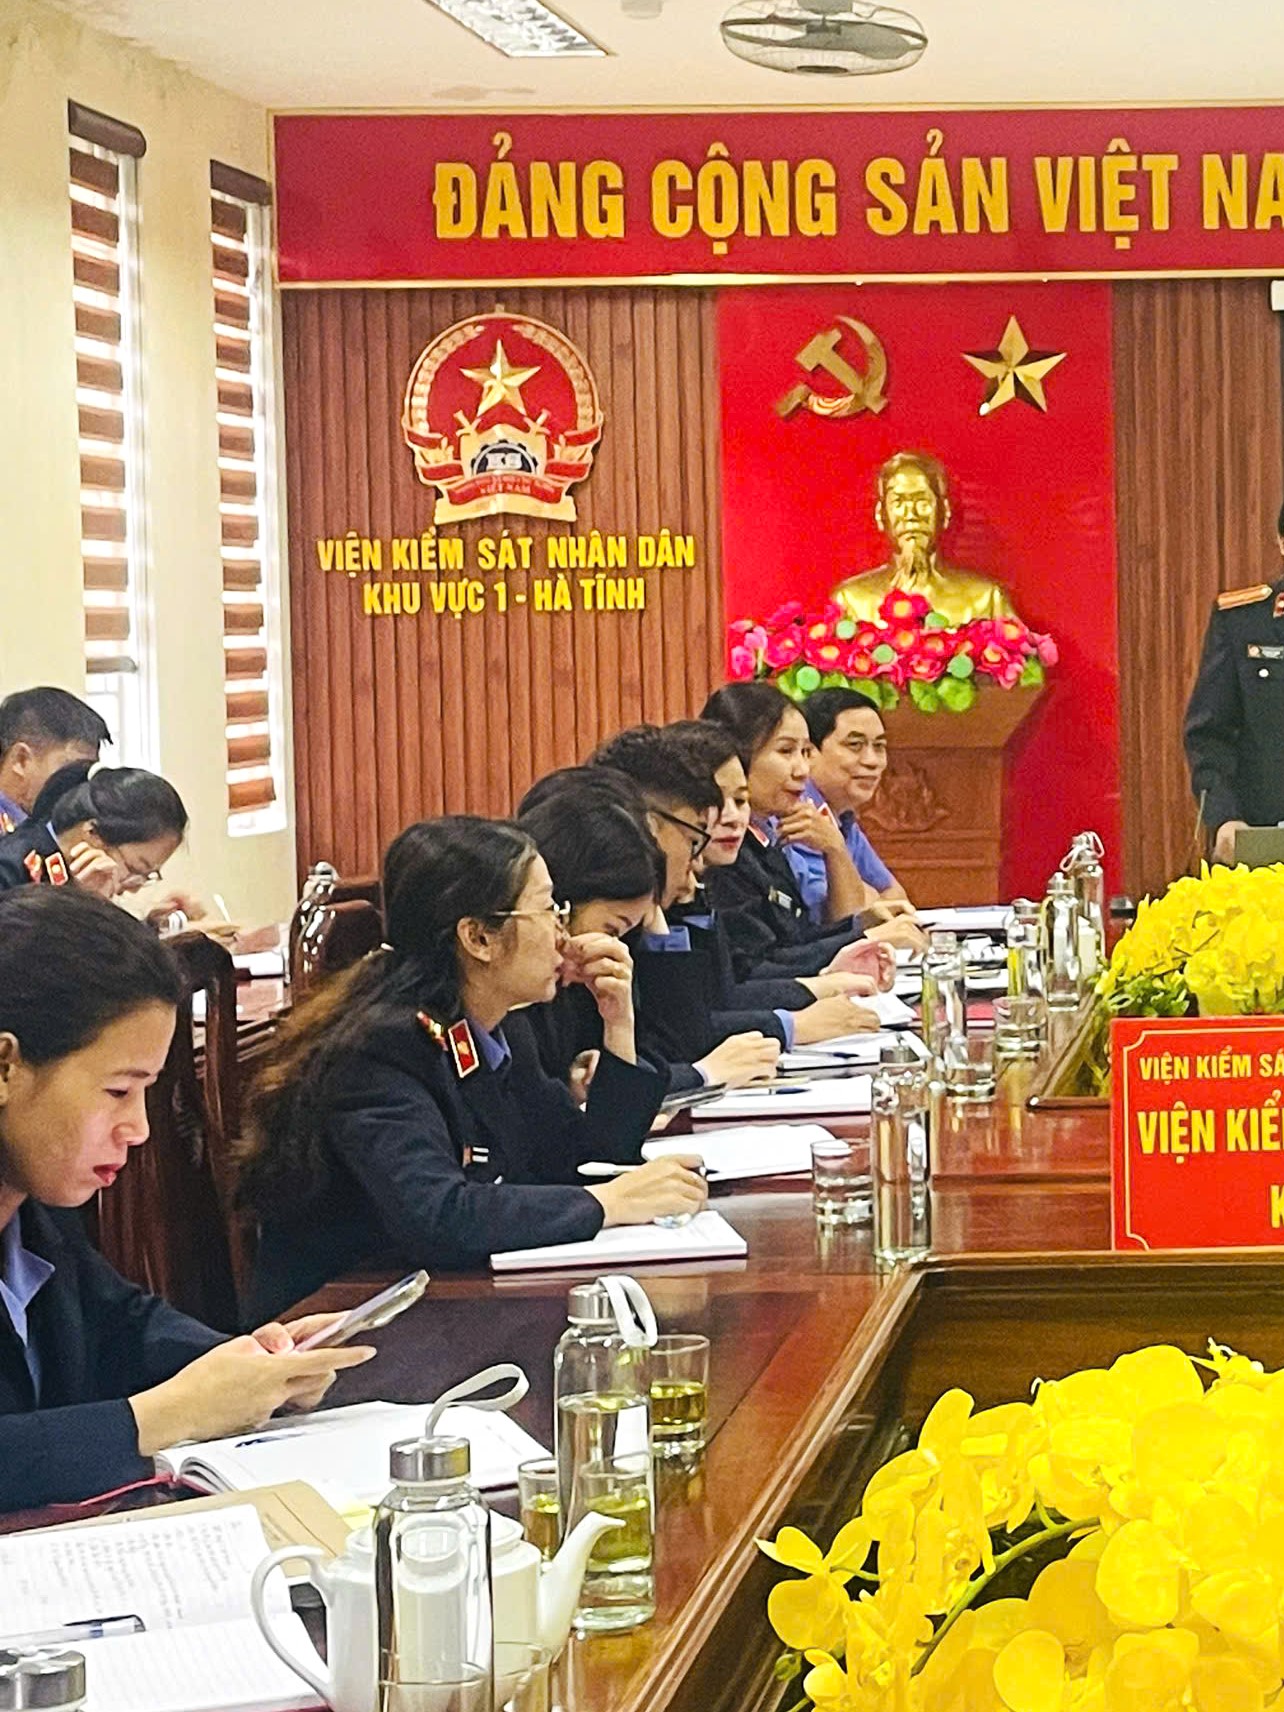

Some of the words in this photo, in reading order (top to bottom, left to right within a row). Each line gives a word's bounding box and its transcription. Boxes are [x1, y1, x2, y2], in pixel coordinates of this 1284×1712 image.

[432, 132, 625, 239] ĐẢNG
[651, 141, 837, 255] CỘNG
[865, 128, 1009, 236] SẢN
[1034, 137, 1179, 250] VIỆT
[317, 531, 383, 578] VIỆN
[392, 526, 465, 571] KIỂM
[477, 529, 533, 571] SÁT
[547, 530, 628, 569] NHÂN
[638, 528, 695, 568] DÂN
[363, 582, 421, 615] KHU
[430, 578, 485, 620] VỰC
[493, 581, 507, 612] 1
[533, 576, 573, 612] HÀ
[579, 573, 646, 611] TĨNH
[1138, 1051, 1190, 1085] VIỆN
[1196, 1043, 1252, 1079] KIỂM
[1136, 1100, 1216, 1164] VIỆN
